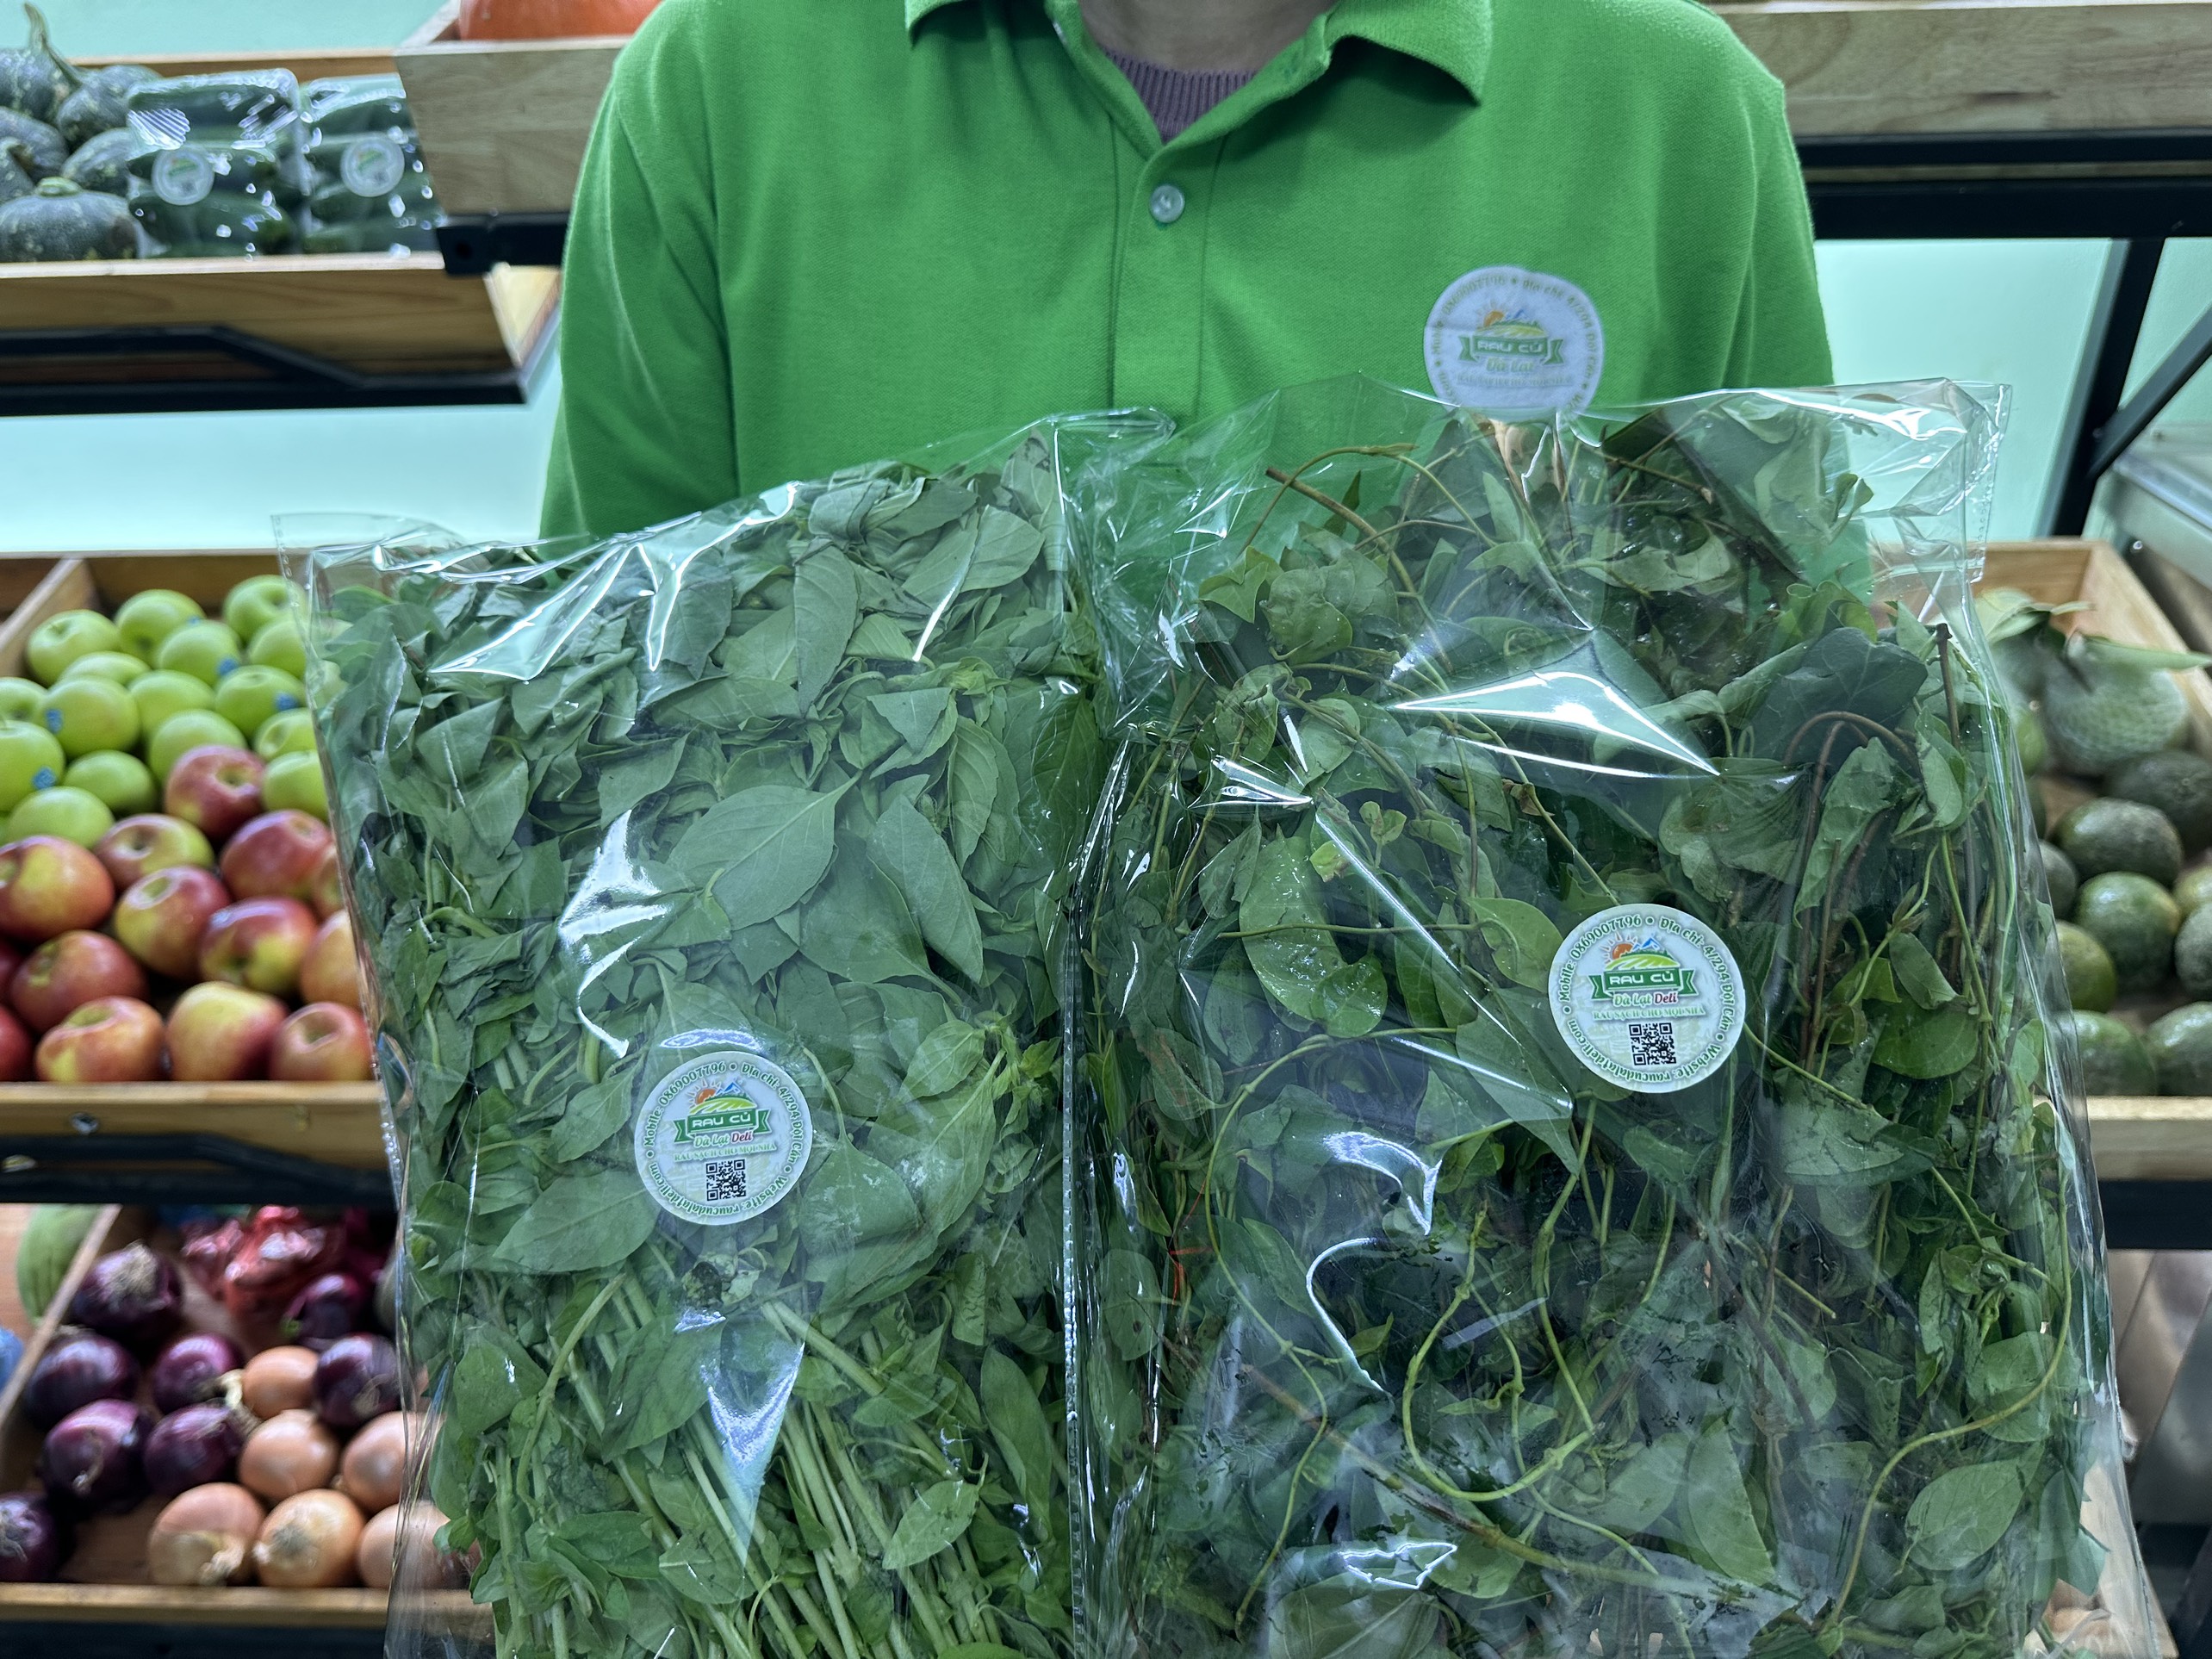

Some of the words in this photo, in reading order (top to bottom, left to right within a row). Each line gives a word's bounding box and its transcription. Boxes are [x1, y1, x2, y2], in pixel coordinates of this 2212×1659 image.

[1477, 340, 1512, 352] RAU
[1559, 960, 1576, 1002] Mobile:
[1569, 915, 1642, 960] 0869007796
[1659, 916, 1681, 935] Địa
[1703, 946, 1731, 981] 4/294
[1609, 974, 1643, 985] RAU
[1632, 992, 1652, 1008] Lạt
[1654, 991, 1677, 1004] Deli
[1593, 1010, 1612, 1020] RAU
[1640, 1007, 1662, 1018] CHO
[1568, 1020, 1671, 1083] raucudalatdeli.com
[1675, 1044, 1721, 1078] Website:
[643, 1107, 664, 1147] Mobile:
[659, 1061, 725, 1106] 0869007796
[742, 1063, 760, 1078] Địa
[779, 1086, 801, 1119] 4/294
[693, 1116, 724, 1128] RAU
[711, 1133, 730, 1146] Lạt
[731, 1129, 753, 1143] Deli
[674, 1151, 693, 1161] RAU
[718, 1146, 737, 1156] CHO
[649, 1163, 741, 1215] raucudalatdeli.com
[743, 1176, 788, 1210] Website:
